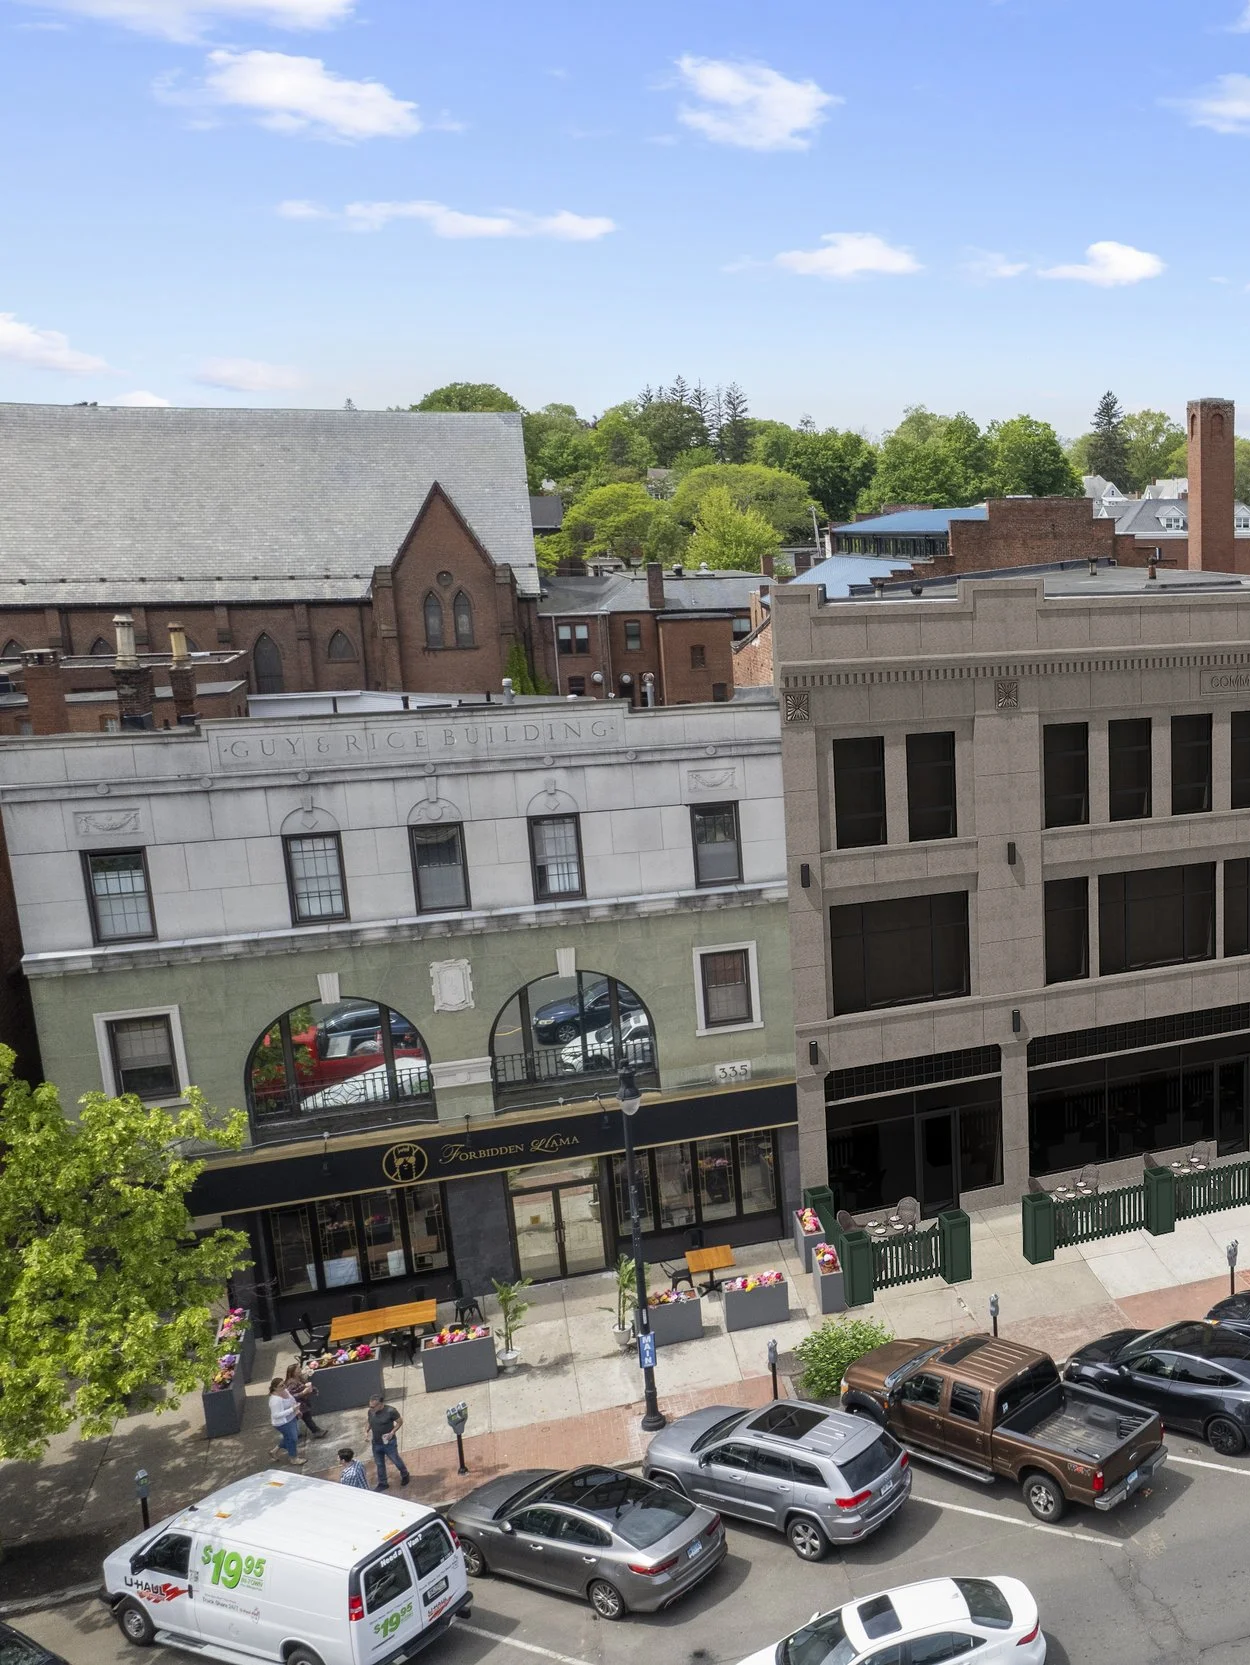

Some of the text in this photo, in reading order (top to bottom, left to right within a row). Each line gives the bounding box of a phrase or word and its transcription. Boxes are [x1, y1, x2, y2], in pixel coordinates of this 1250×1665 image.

[230, 720, 607, 758] GUY & RICE BUILDING
[719, 1064, 748, 1079] 335
[642, 1335, 653, 1365] MAIN
[380, 1550, 398, 1568] Need
[124, 1575, 166, 1597] U-HAUL
